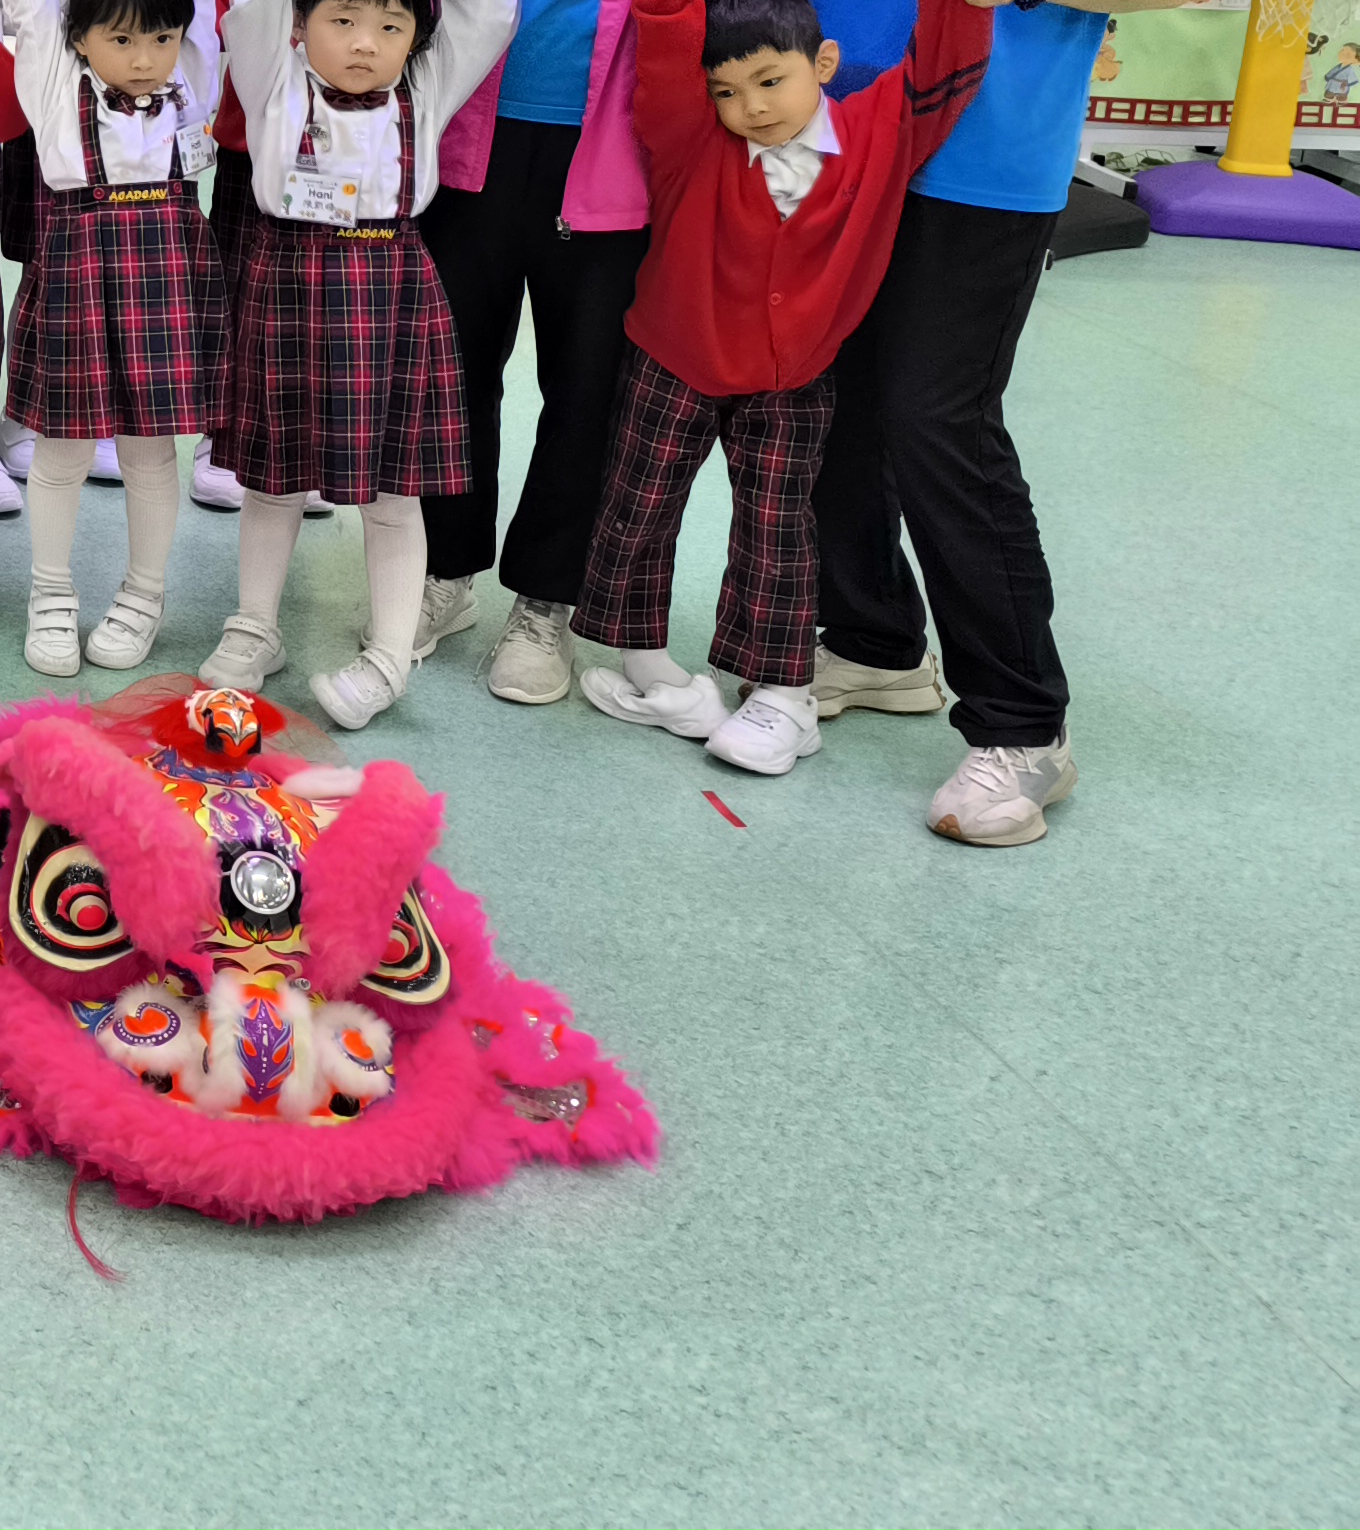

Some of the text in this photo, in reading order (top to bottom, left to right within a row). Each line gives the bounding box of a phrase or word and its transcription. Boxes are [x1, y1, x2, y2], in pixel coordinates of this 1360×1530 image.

[109, 188, 168, 201] ACADEMY
[308, 188, 333, 201] Hani
[336, 228, 396, 239] ACADEMY
